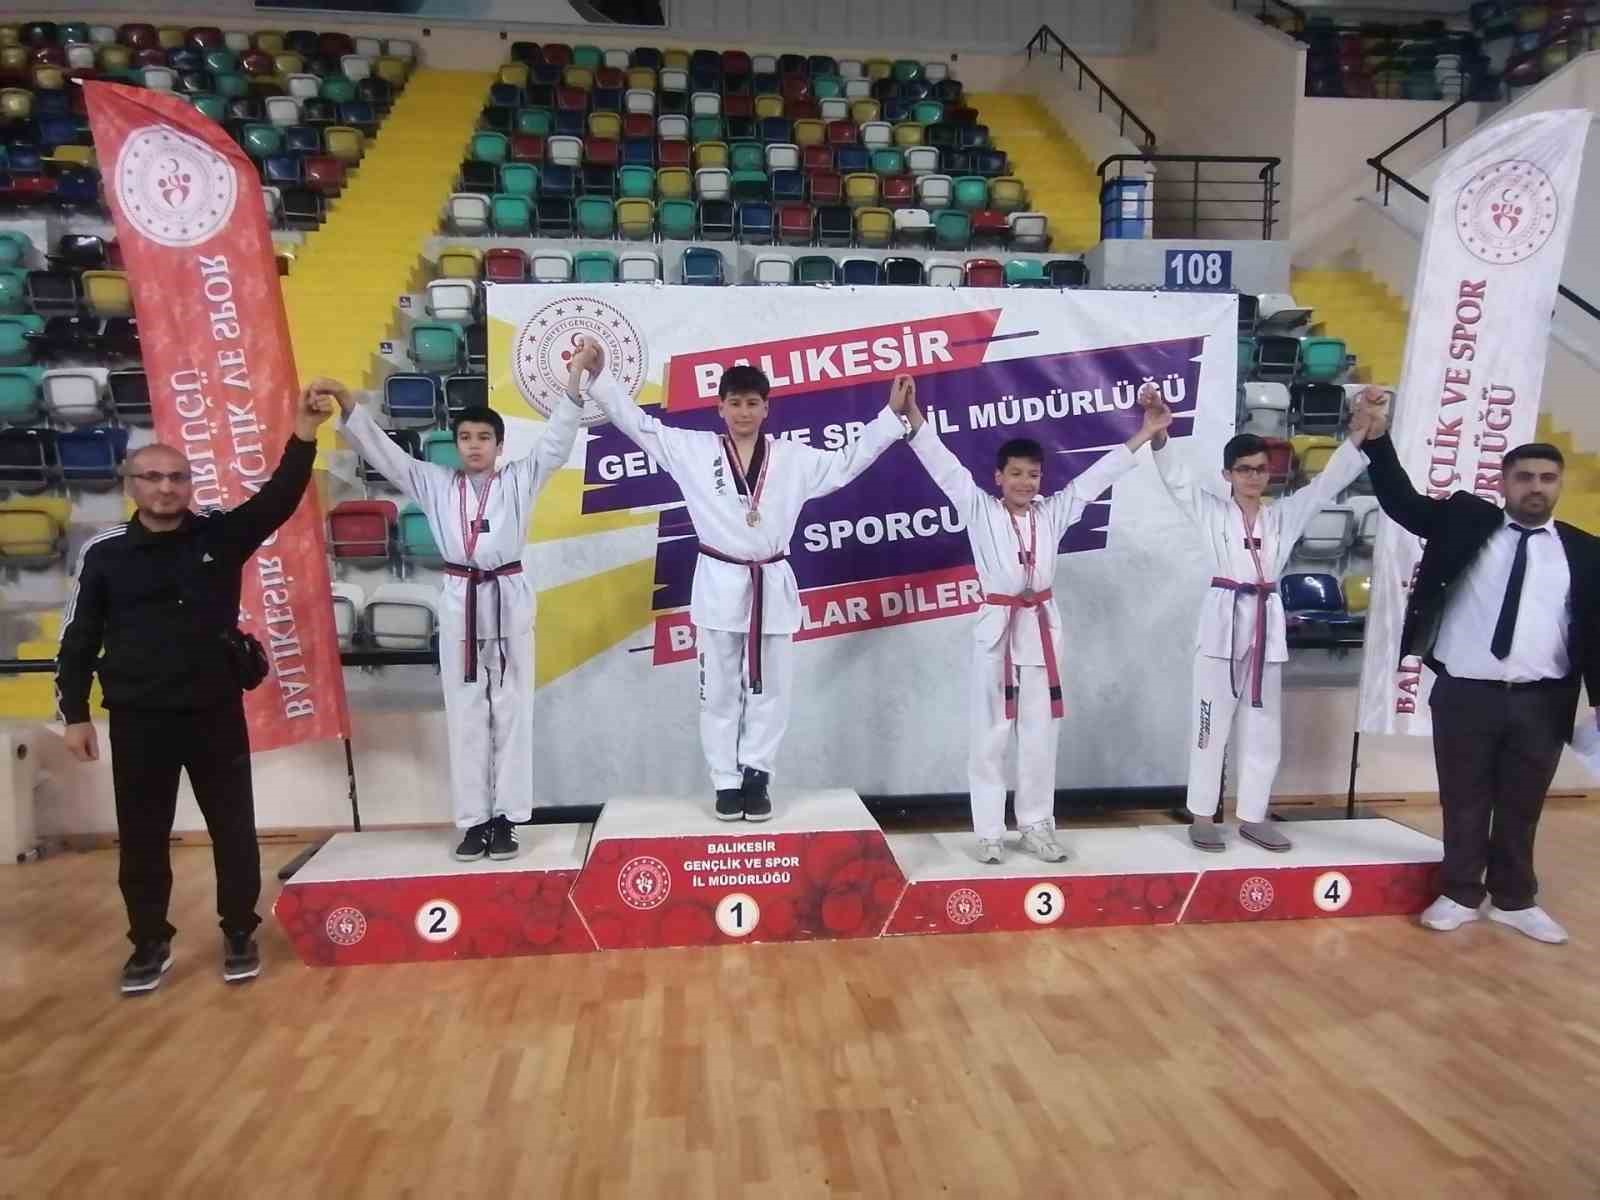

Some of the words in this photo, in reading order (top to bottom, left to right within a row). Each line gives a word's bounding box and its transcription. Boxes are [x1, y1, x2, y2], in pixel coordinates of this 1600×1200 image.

[1170, 253, 1223, 285] 108
[1450, 279, 1487, 362] SPOR
[694, 326, 954, 398] BLIKESİR
[1441, 367, 1472, 407] VE
[927, 405, 960, 434] İL
[880, 573, 984, 618] DİLER
[707, 840, 776, 855] BALIKESİR
[684, 857, 741, 873] GENÇLİK
[745, 858, 762, 869] VE
[765, 857, 800, 868] SPOR
[692, 874, 705, 887] İL
[709, 871, 791, 887] MÜDÜRLÜĞÜ
[1324, 880, 1340, 903] 4
[730, 902, 742, 928] 1
[1036, 892, 1052, 916] 3
[429, 907, 447, 934] 2
